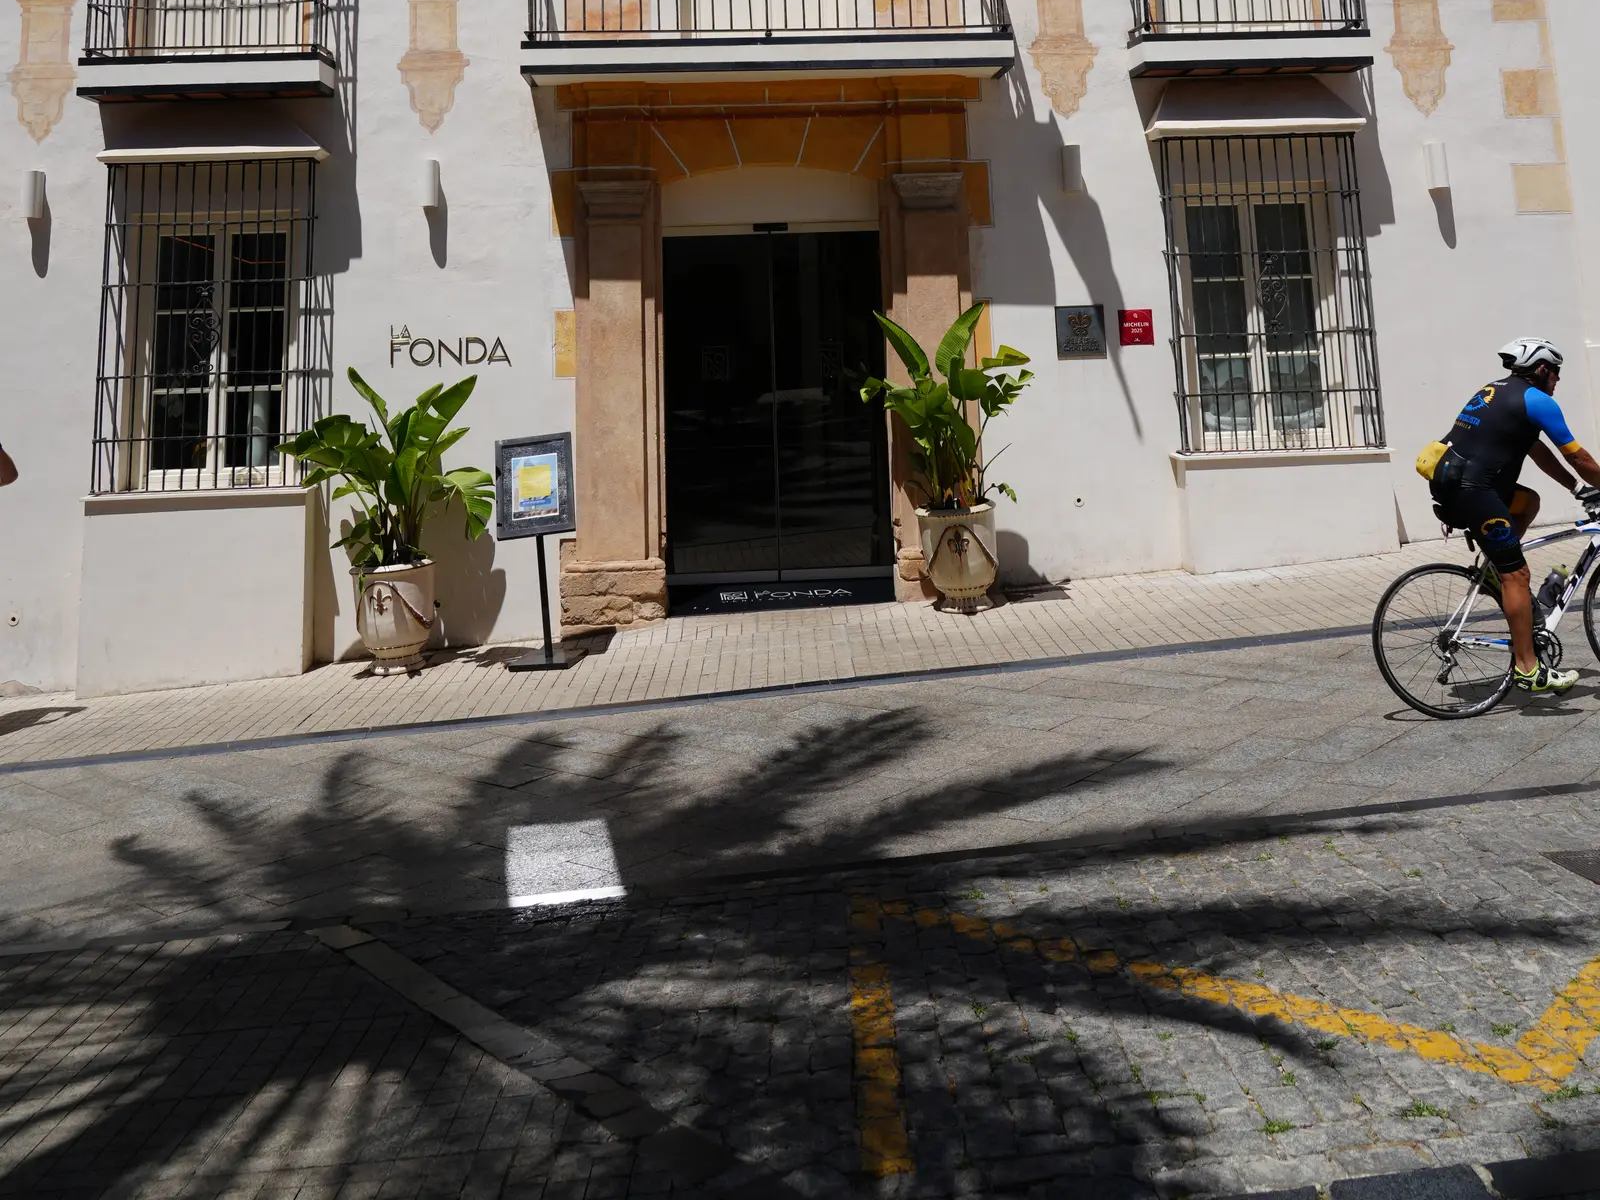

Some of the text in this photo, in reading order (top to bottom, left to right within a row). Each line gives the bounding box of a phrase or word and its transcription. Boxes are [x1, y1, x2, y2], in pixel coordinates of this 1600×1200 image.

[390, 324, 412, 340] LA
[390, 336, 512, 368] FONDA
[755, 589, 852, 599] FONDA
